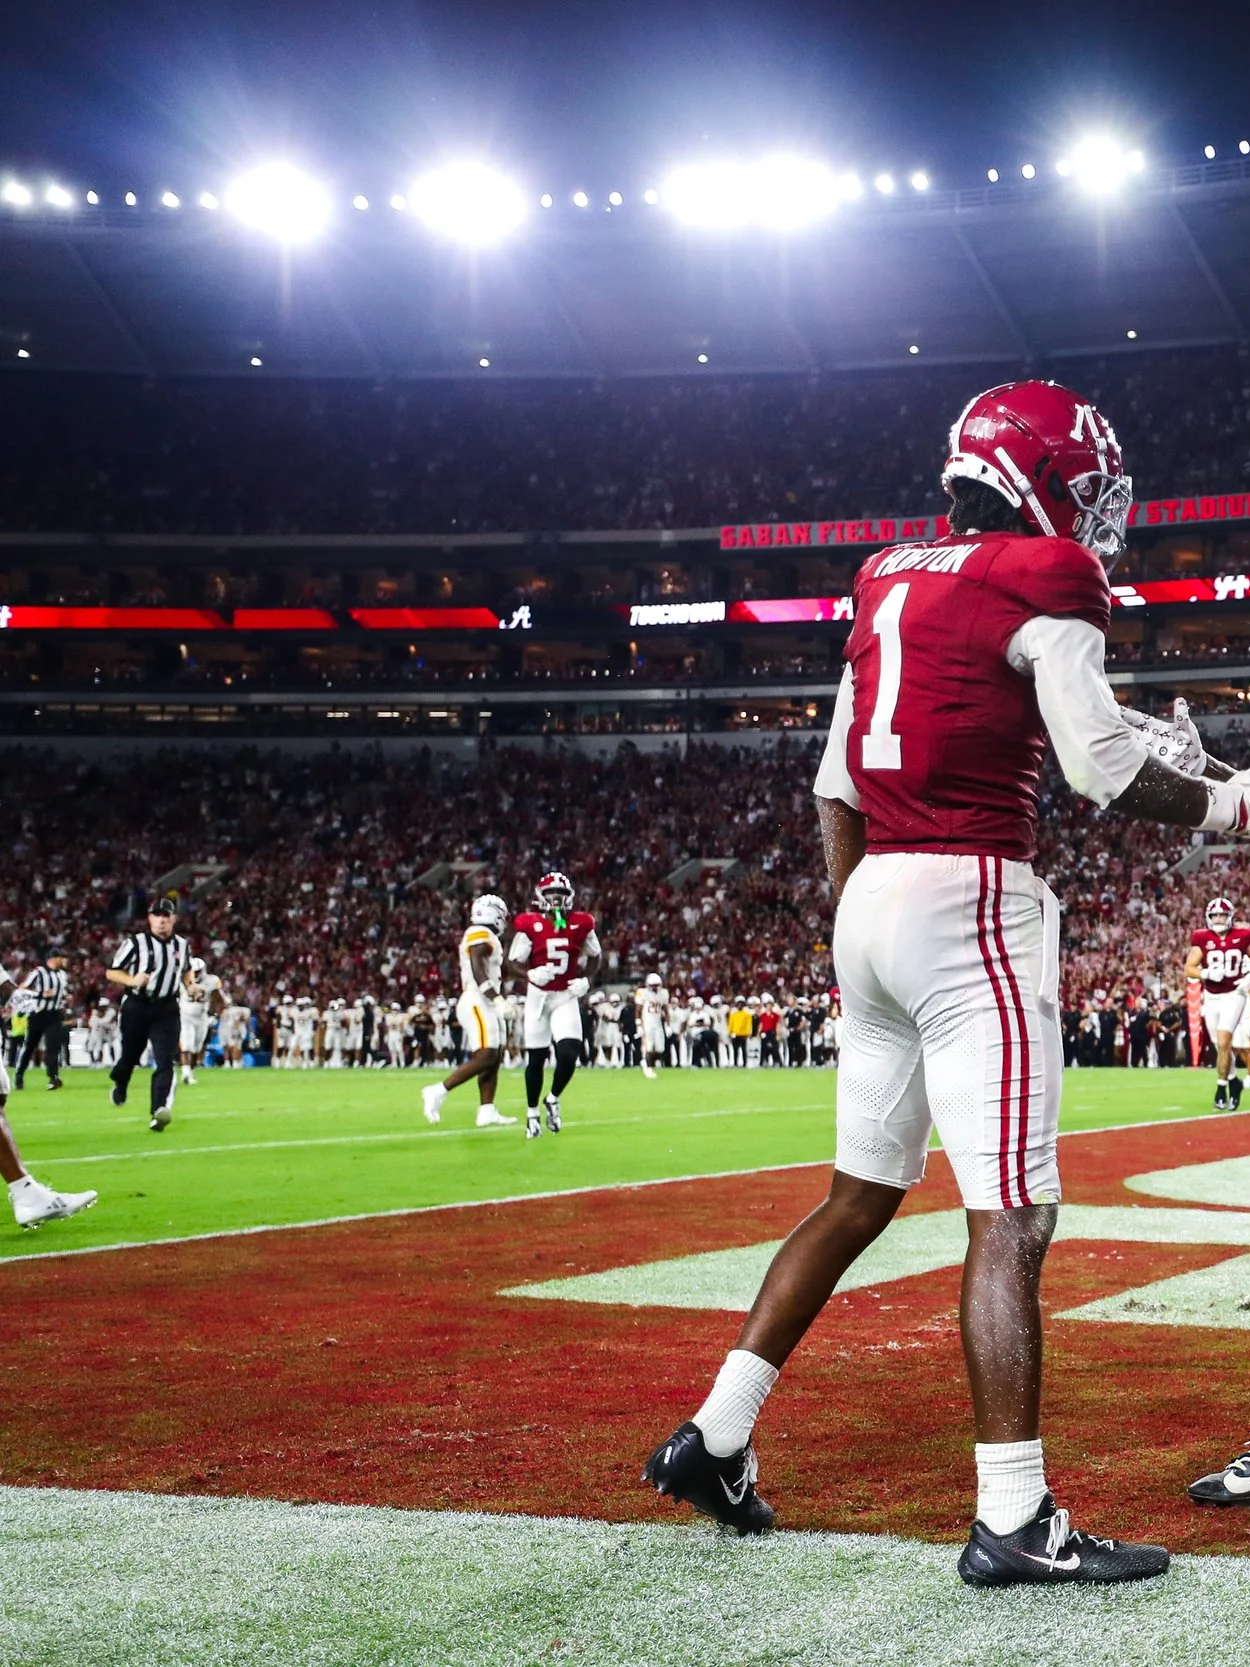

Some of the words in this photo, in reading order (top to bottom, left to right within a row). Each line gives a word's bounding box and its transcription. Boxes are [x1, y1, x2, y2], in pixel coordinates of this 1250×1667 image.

[720, 523, 811, 549] SABAN
[818, 519, 896, 544] FIELD
[902, 520, 929, 538] AT
[873, 543, 982, 578] HORTON
[629, 601, 726, 626] TOUCHDOWN
[862, 583, 911, 770] 1
[546, 937, 570, 976] 5
[1206, 948, 1243, 978] 80
